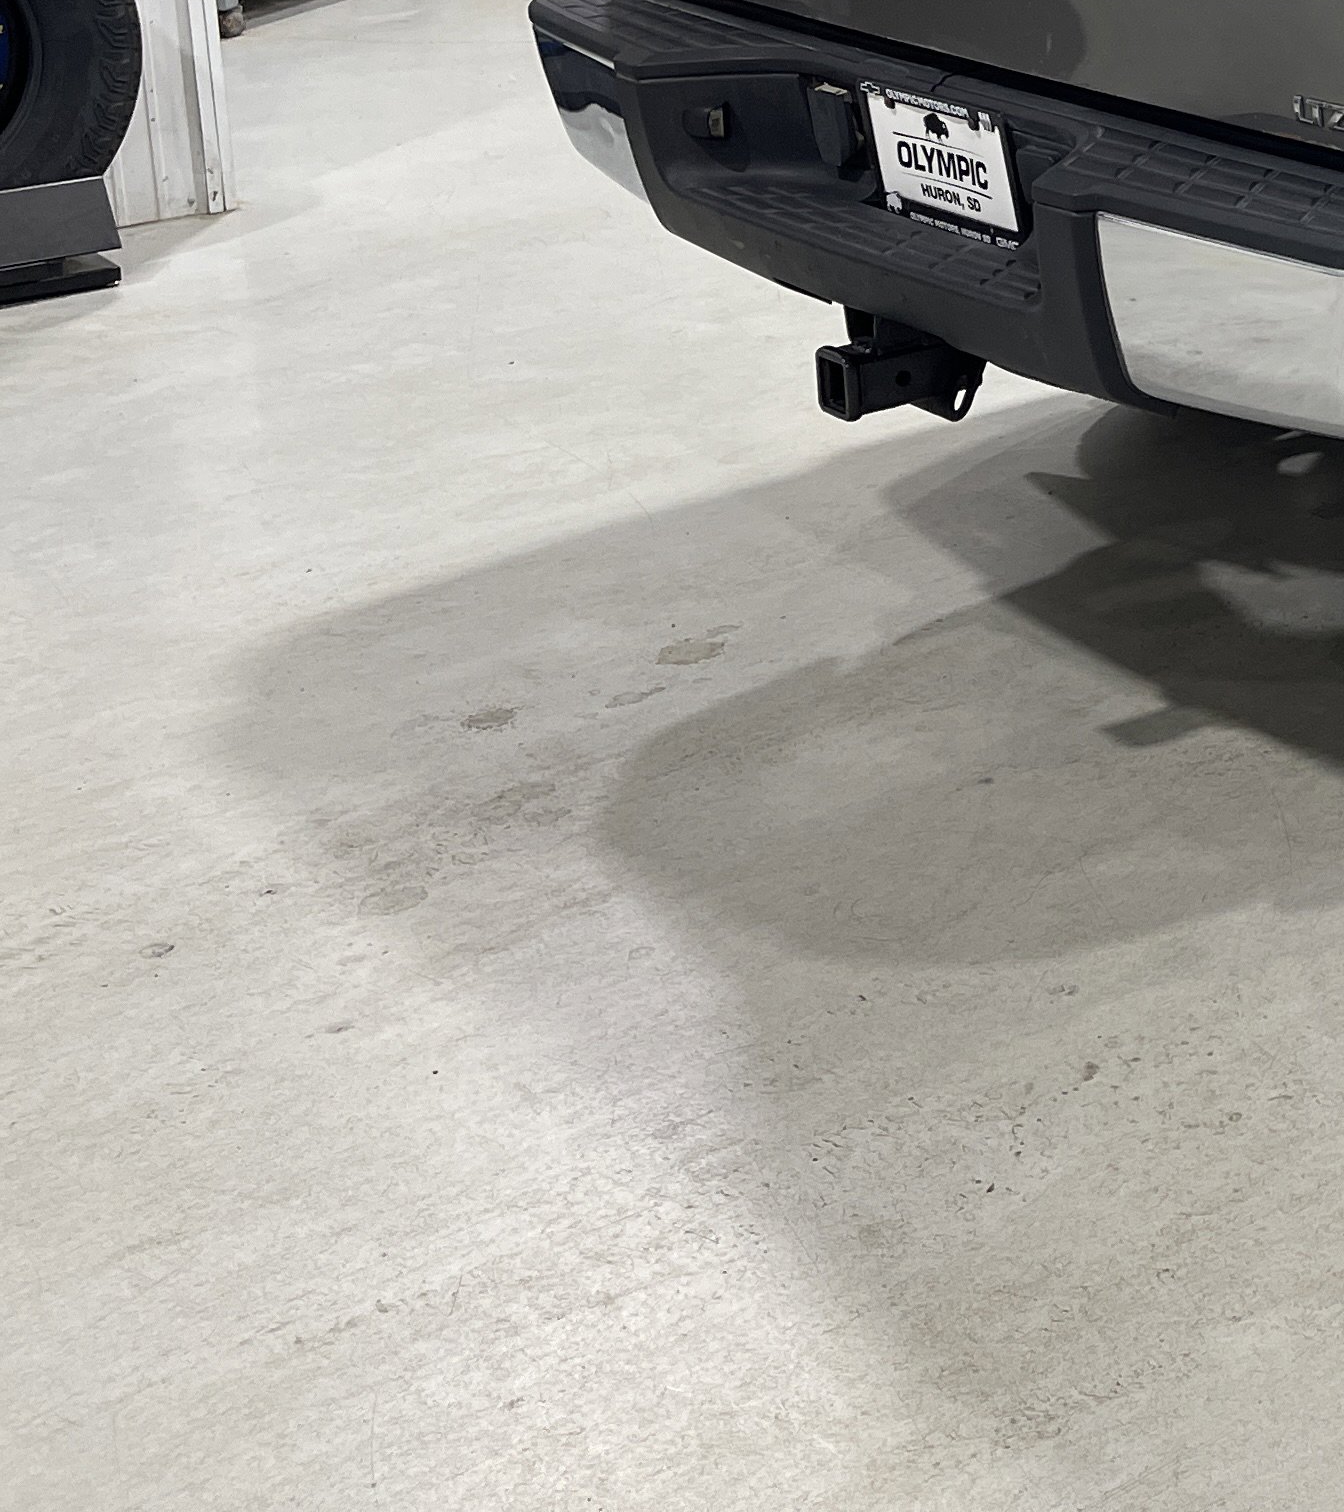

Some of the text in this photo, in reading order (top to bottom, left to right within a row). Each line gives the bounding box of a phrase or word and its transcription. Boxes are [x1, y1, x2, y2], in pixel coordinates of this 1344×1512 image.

[897, 140, 988, 190] OLYMPIC
[921, 183, 982, 213] HURON, SD
